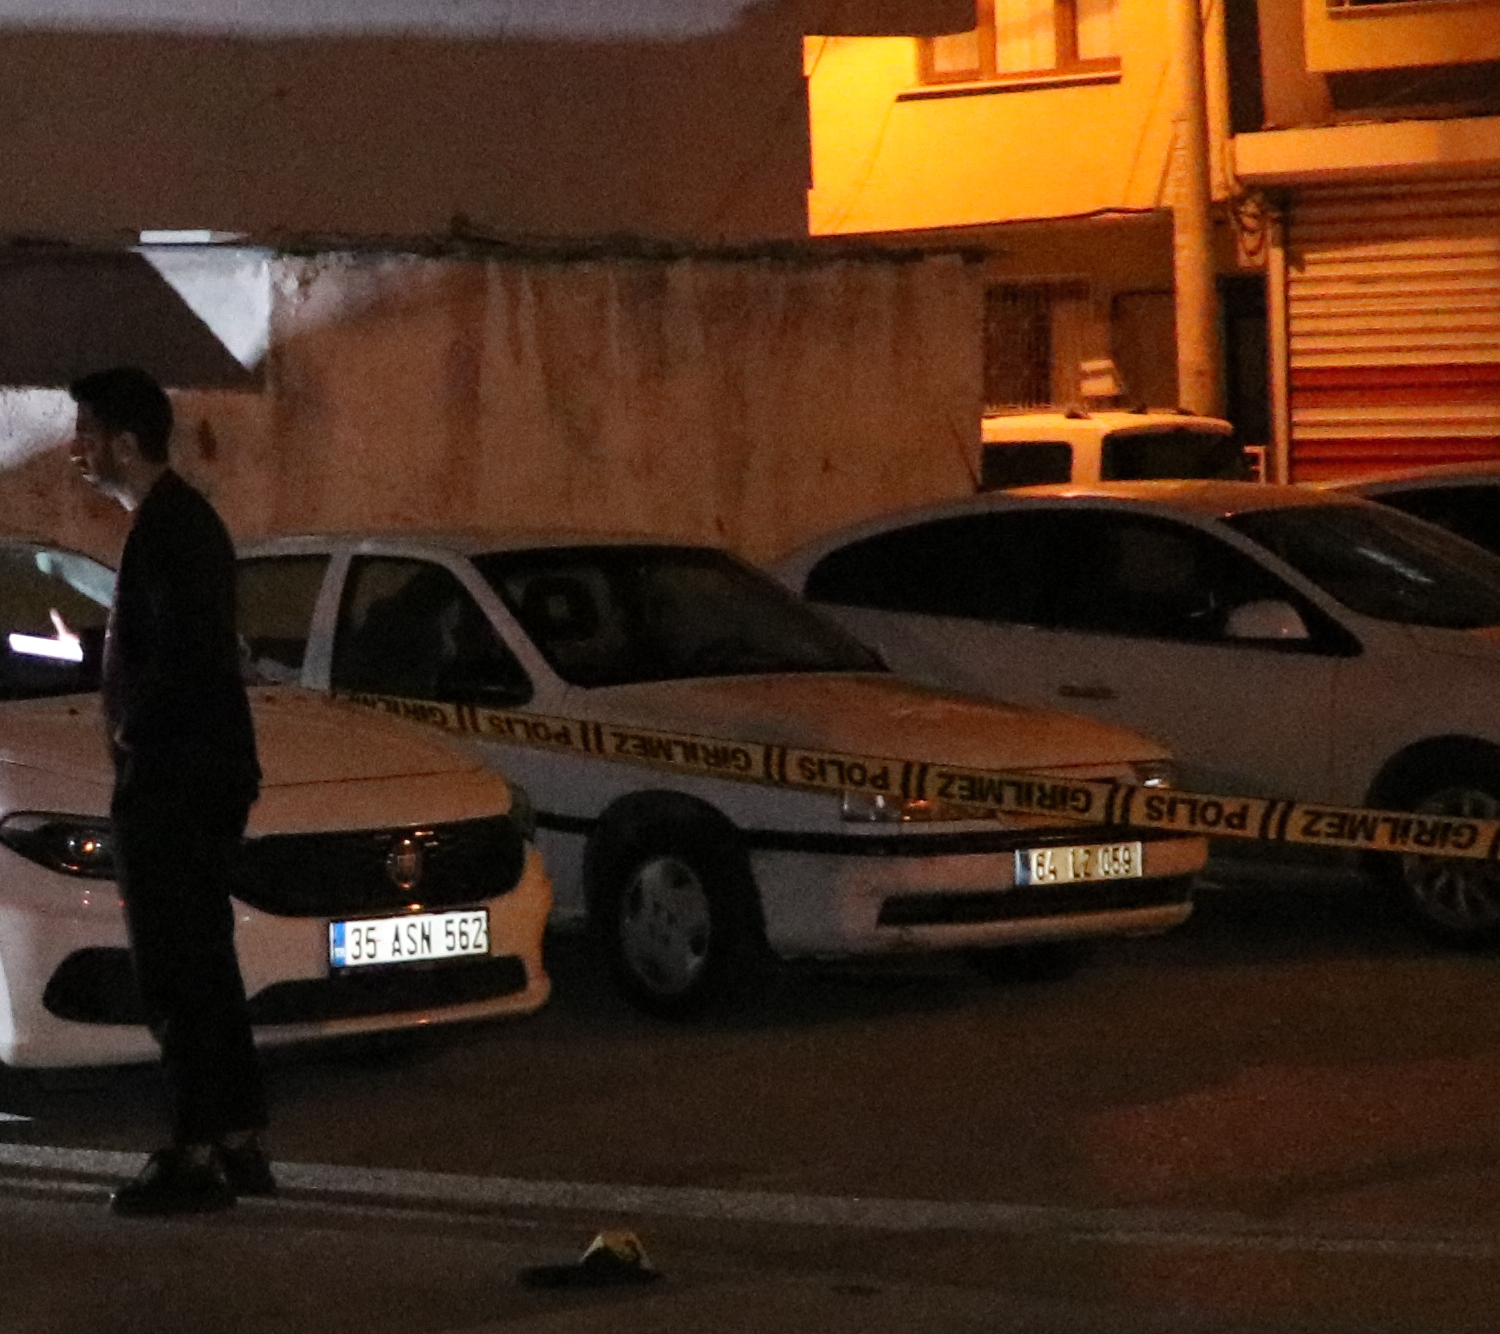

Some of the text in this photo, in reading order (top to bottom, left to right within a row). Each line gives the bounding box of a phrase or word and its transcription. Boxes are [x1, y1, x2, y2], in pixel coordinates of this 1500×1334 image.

[350, 917, 484, 960] 35 ASN 562
